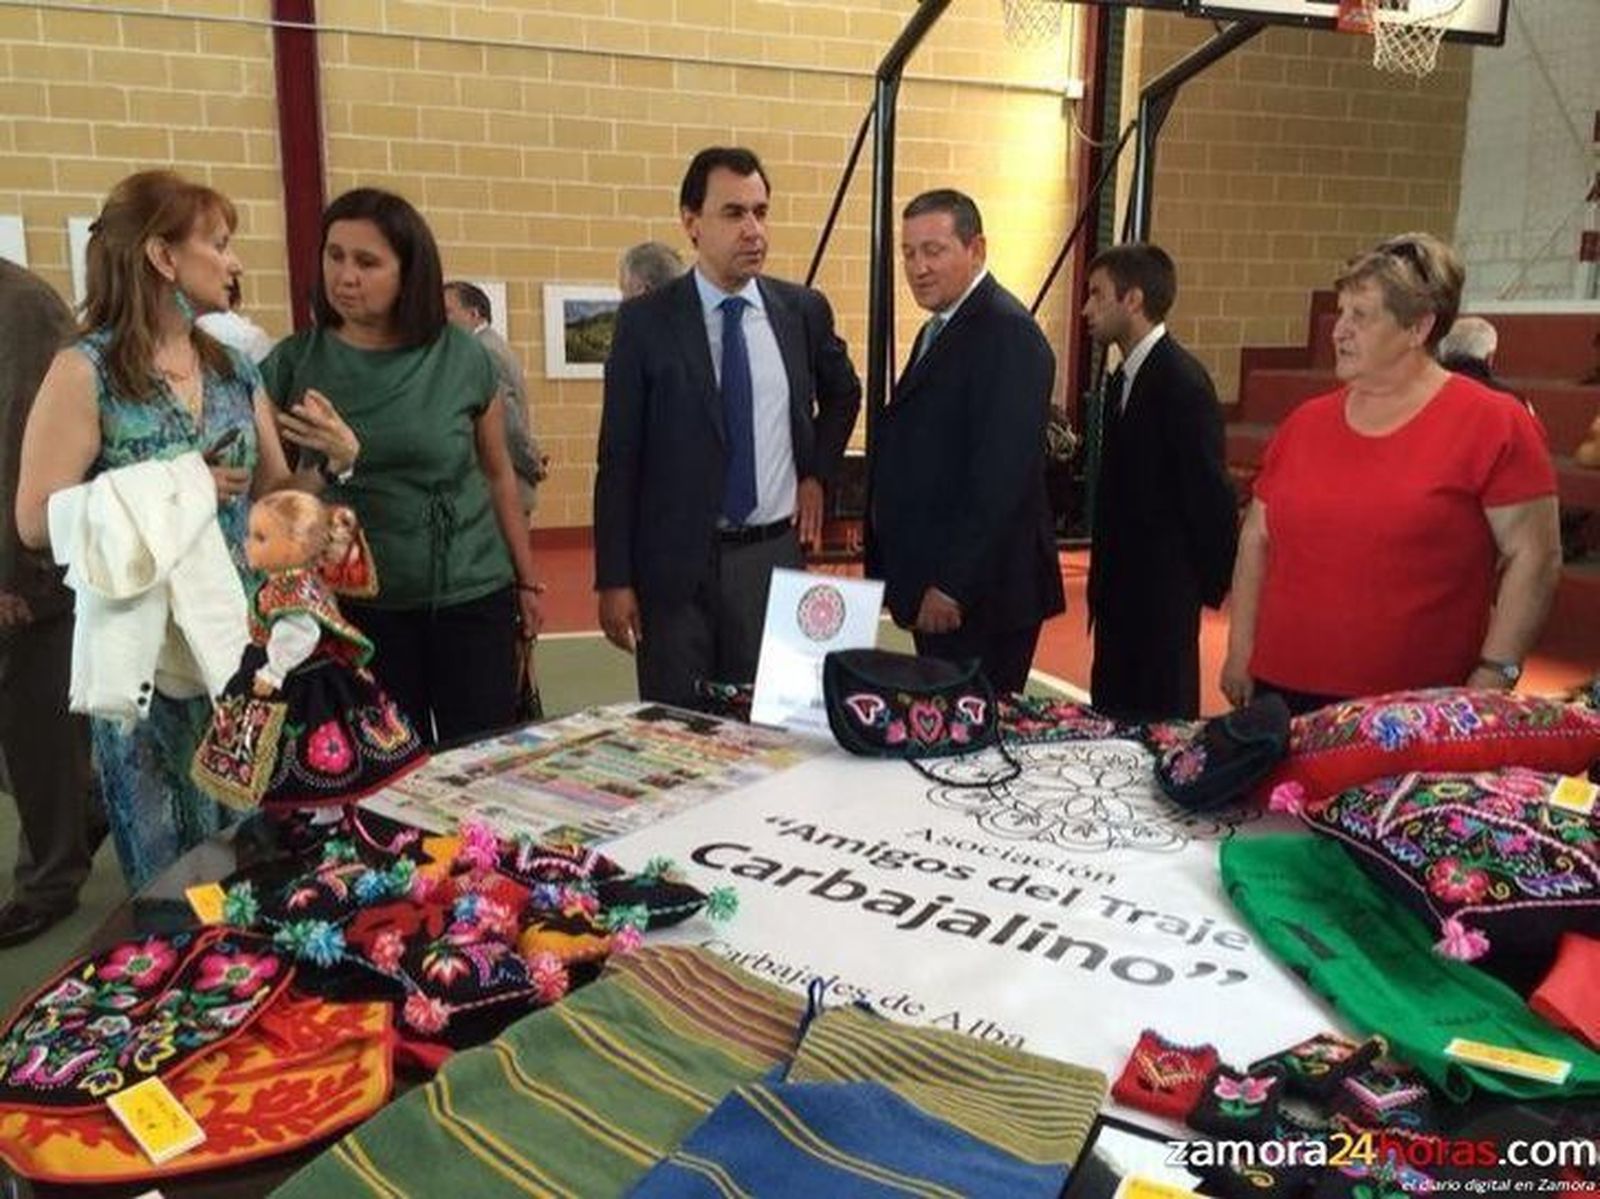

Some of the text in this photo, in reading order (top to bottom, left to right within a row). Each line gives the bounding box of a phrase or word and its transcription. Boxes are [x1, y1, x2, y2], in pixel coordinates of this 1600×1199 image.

[904, 827, 1117, 885] Asociación
[987, 873, 1082, 907] del
[1100, 894, 1251, 951] Traje
[881, 990, 925, 1018] de
[932, 1010, 1027, 1050] Alba
